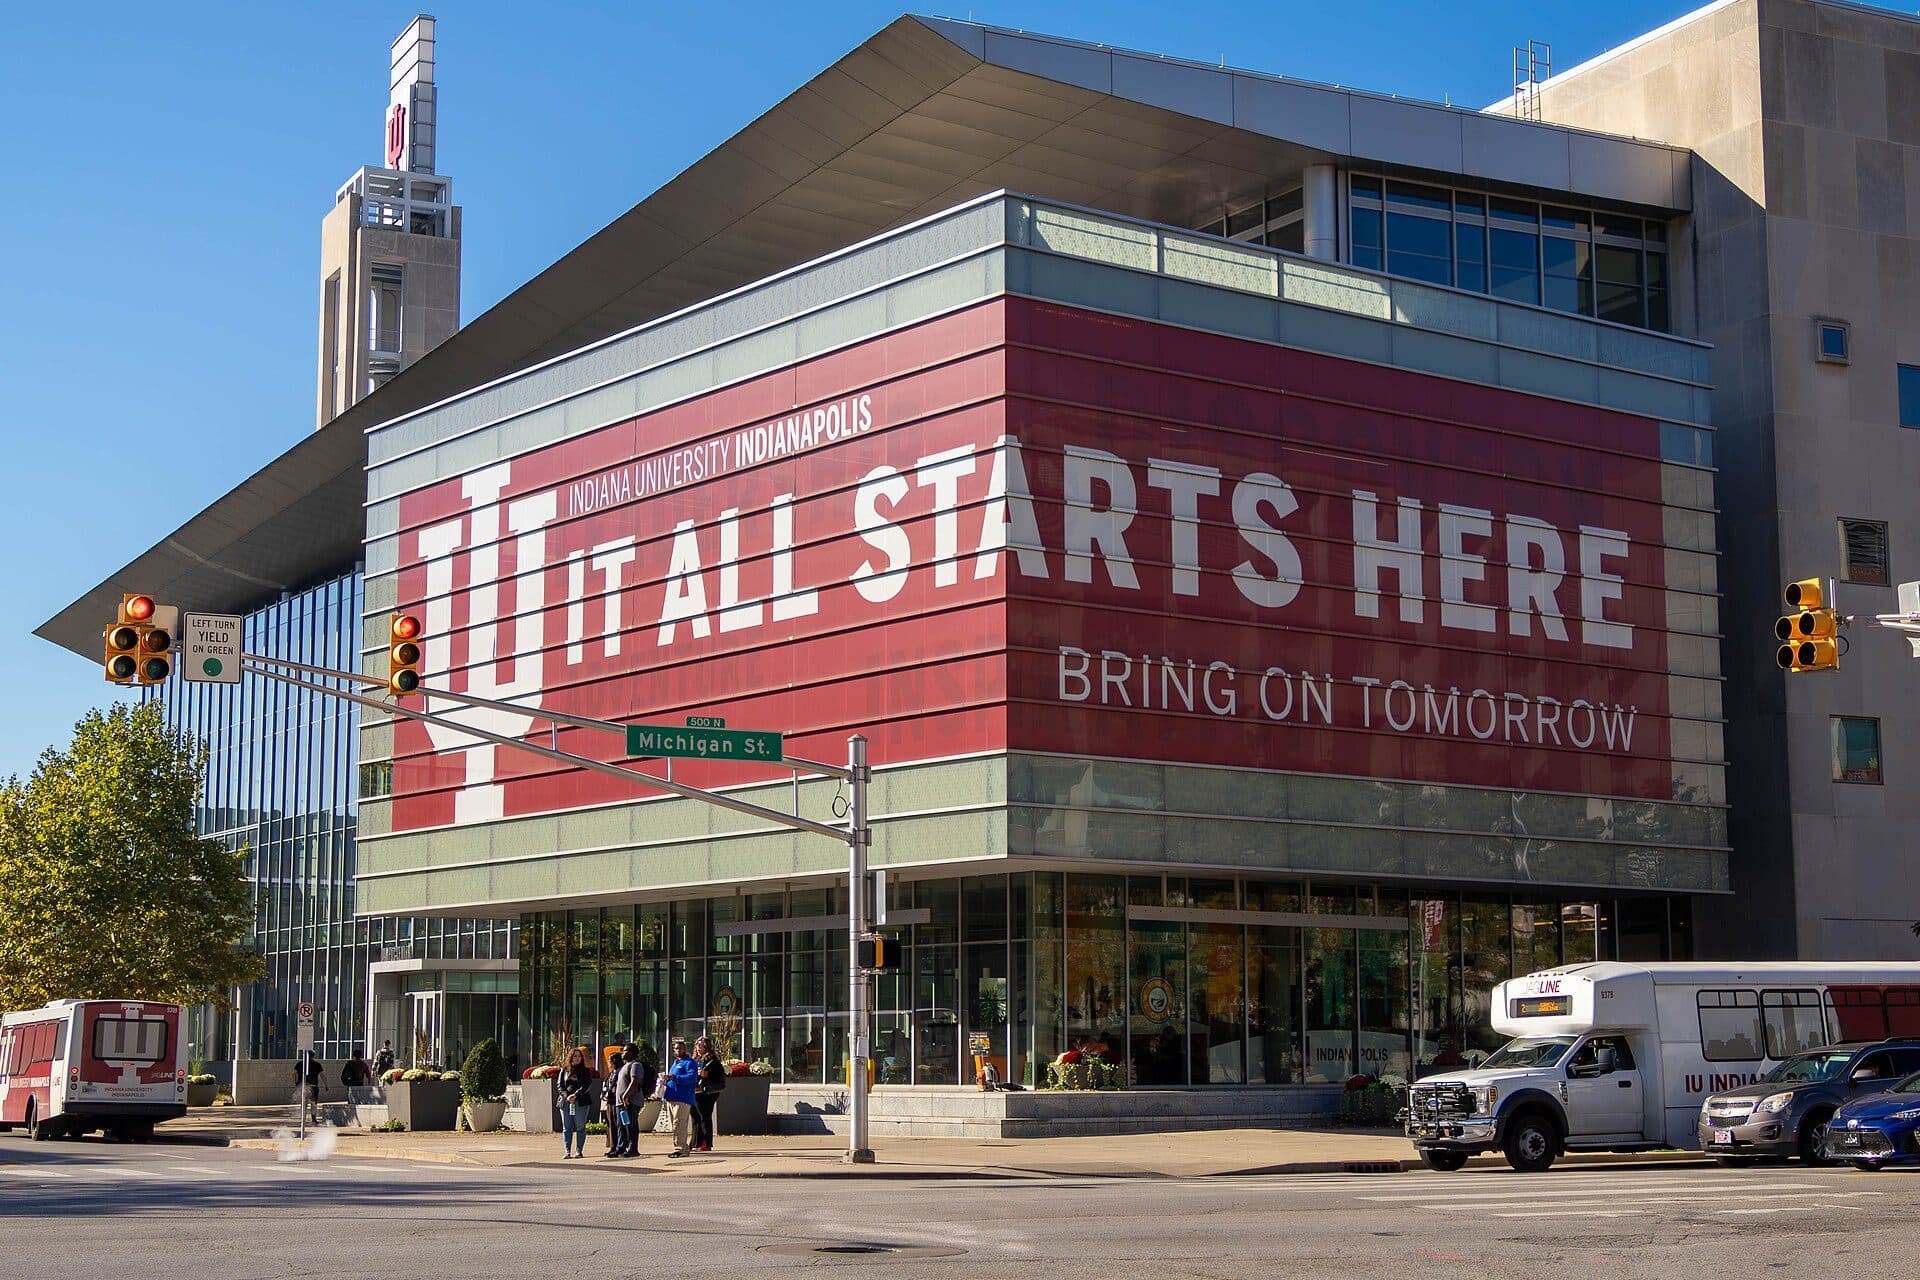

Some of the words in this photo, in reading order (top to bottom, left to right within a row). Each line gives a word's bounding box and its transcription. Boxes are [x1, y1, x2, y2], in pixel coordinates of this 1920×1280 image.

[569, 474, 632, 516] INDIANA
[633, 437, 730, 498] UNIVERSITY
[734, 395, 873, 465] INDIANAPOLIS
[565, 534, 637, 665] IT
[657, 492, 820, 647] ALL
[849, 433, 1305, 609] STARTS
[1352, 489, 1634, 650] HERE
[192, 619, 211, 627] LEFT
[214, 620, 235, 630] TURN
[198, 631, 229, 643] YIELD
[192, 645, 204, 654] ON
[207, 645, 234, 655] GREEN
[1057, 645, 1236, 716] BRING
[1260, 666, 1334, 726] ON
[1351, 675, 1638, 754] TOMORROW
[690, 717, 710, 727] 500
[712, 718, 721, 728] N
[638, 732, 733, 757] Michigan
[743, 738, 771, 755] St.
[1316, 1047, 1389, 1062] INDIANPOLIS
[1685, 1074, 1703, 1093] IU
